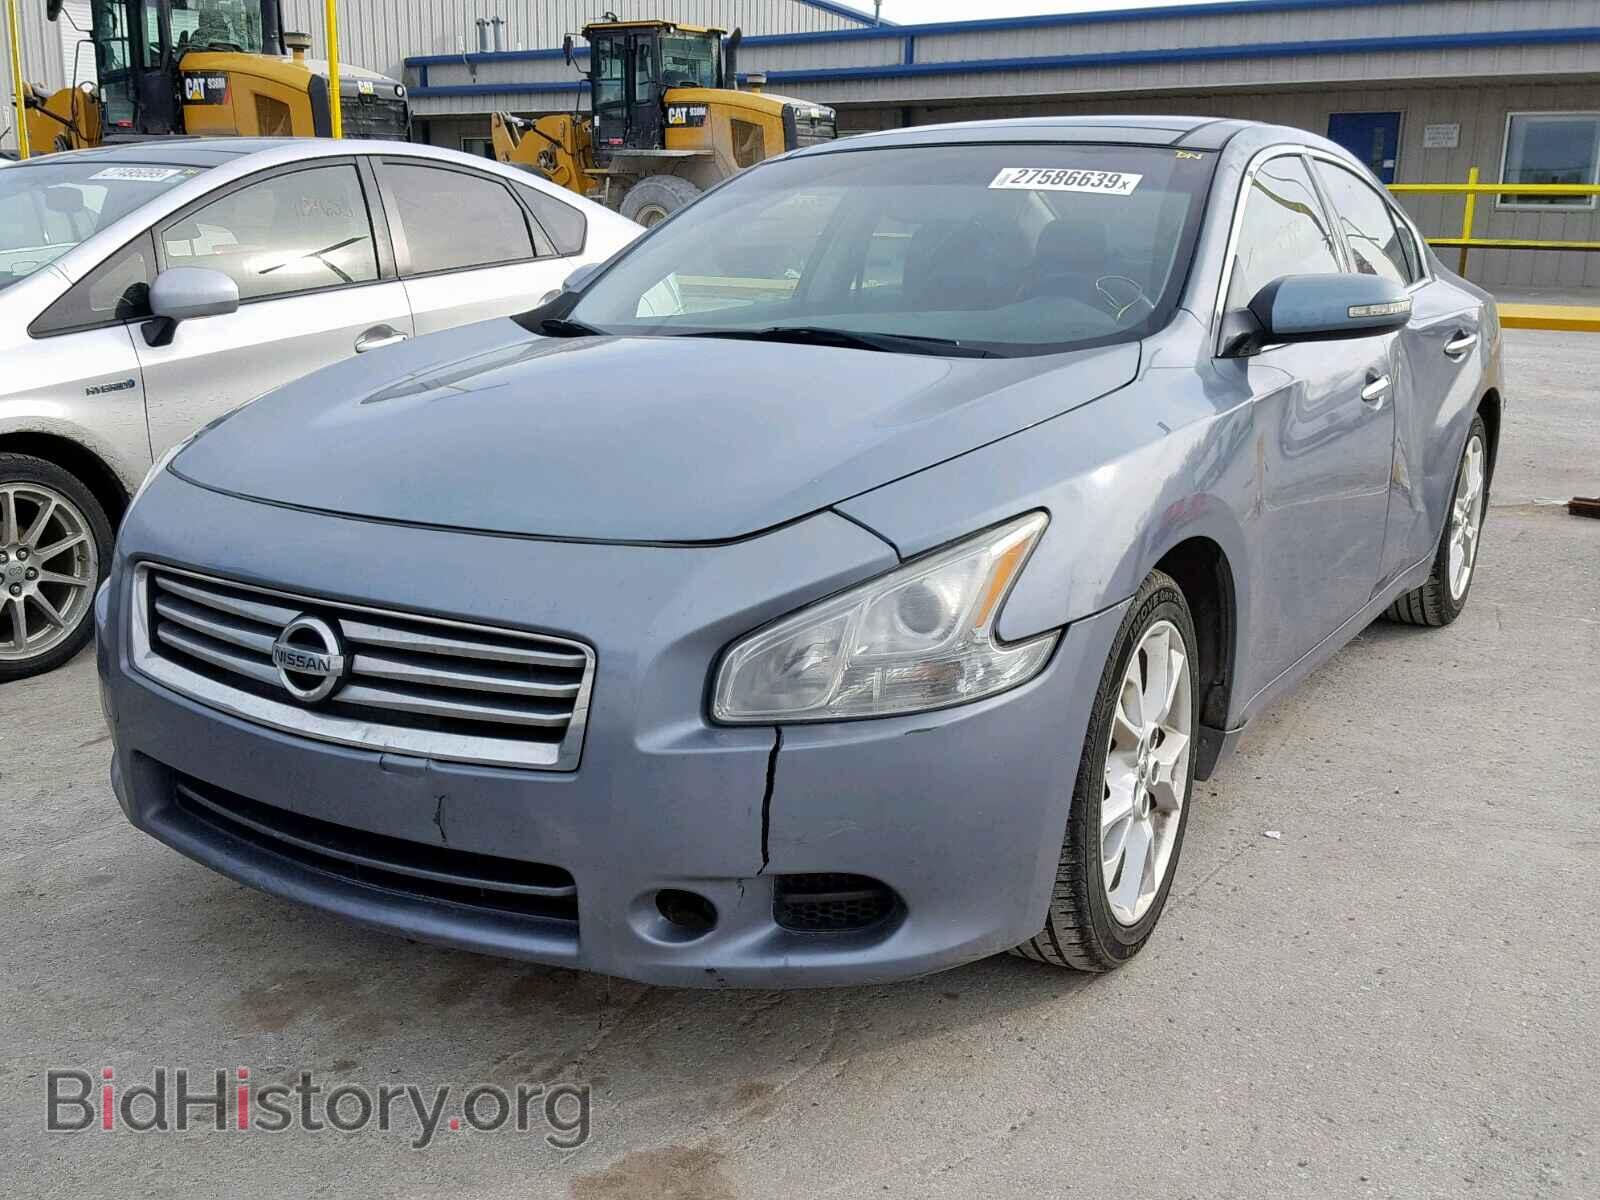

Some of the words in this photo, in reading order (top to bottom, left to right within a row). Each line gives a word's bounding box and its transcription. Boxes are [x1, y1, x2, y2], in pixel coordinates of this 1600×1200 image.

[185, 78, 205, 100] CAT
[668, 107, 687, 124] CAT
[274, 647, 331, 673] NISSAN
